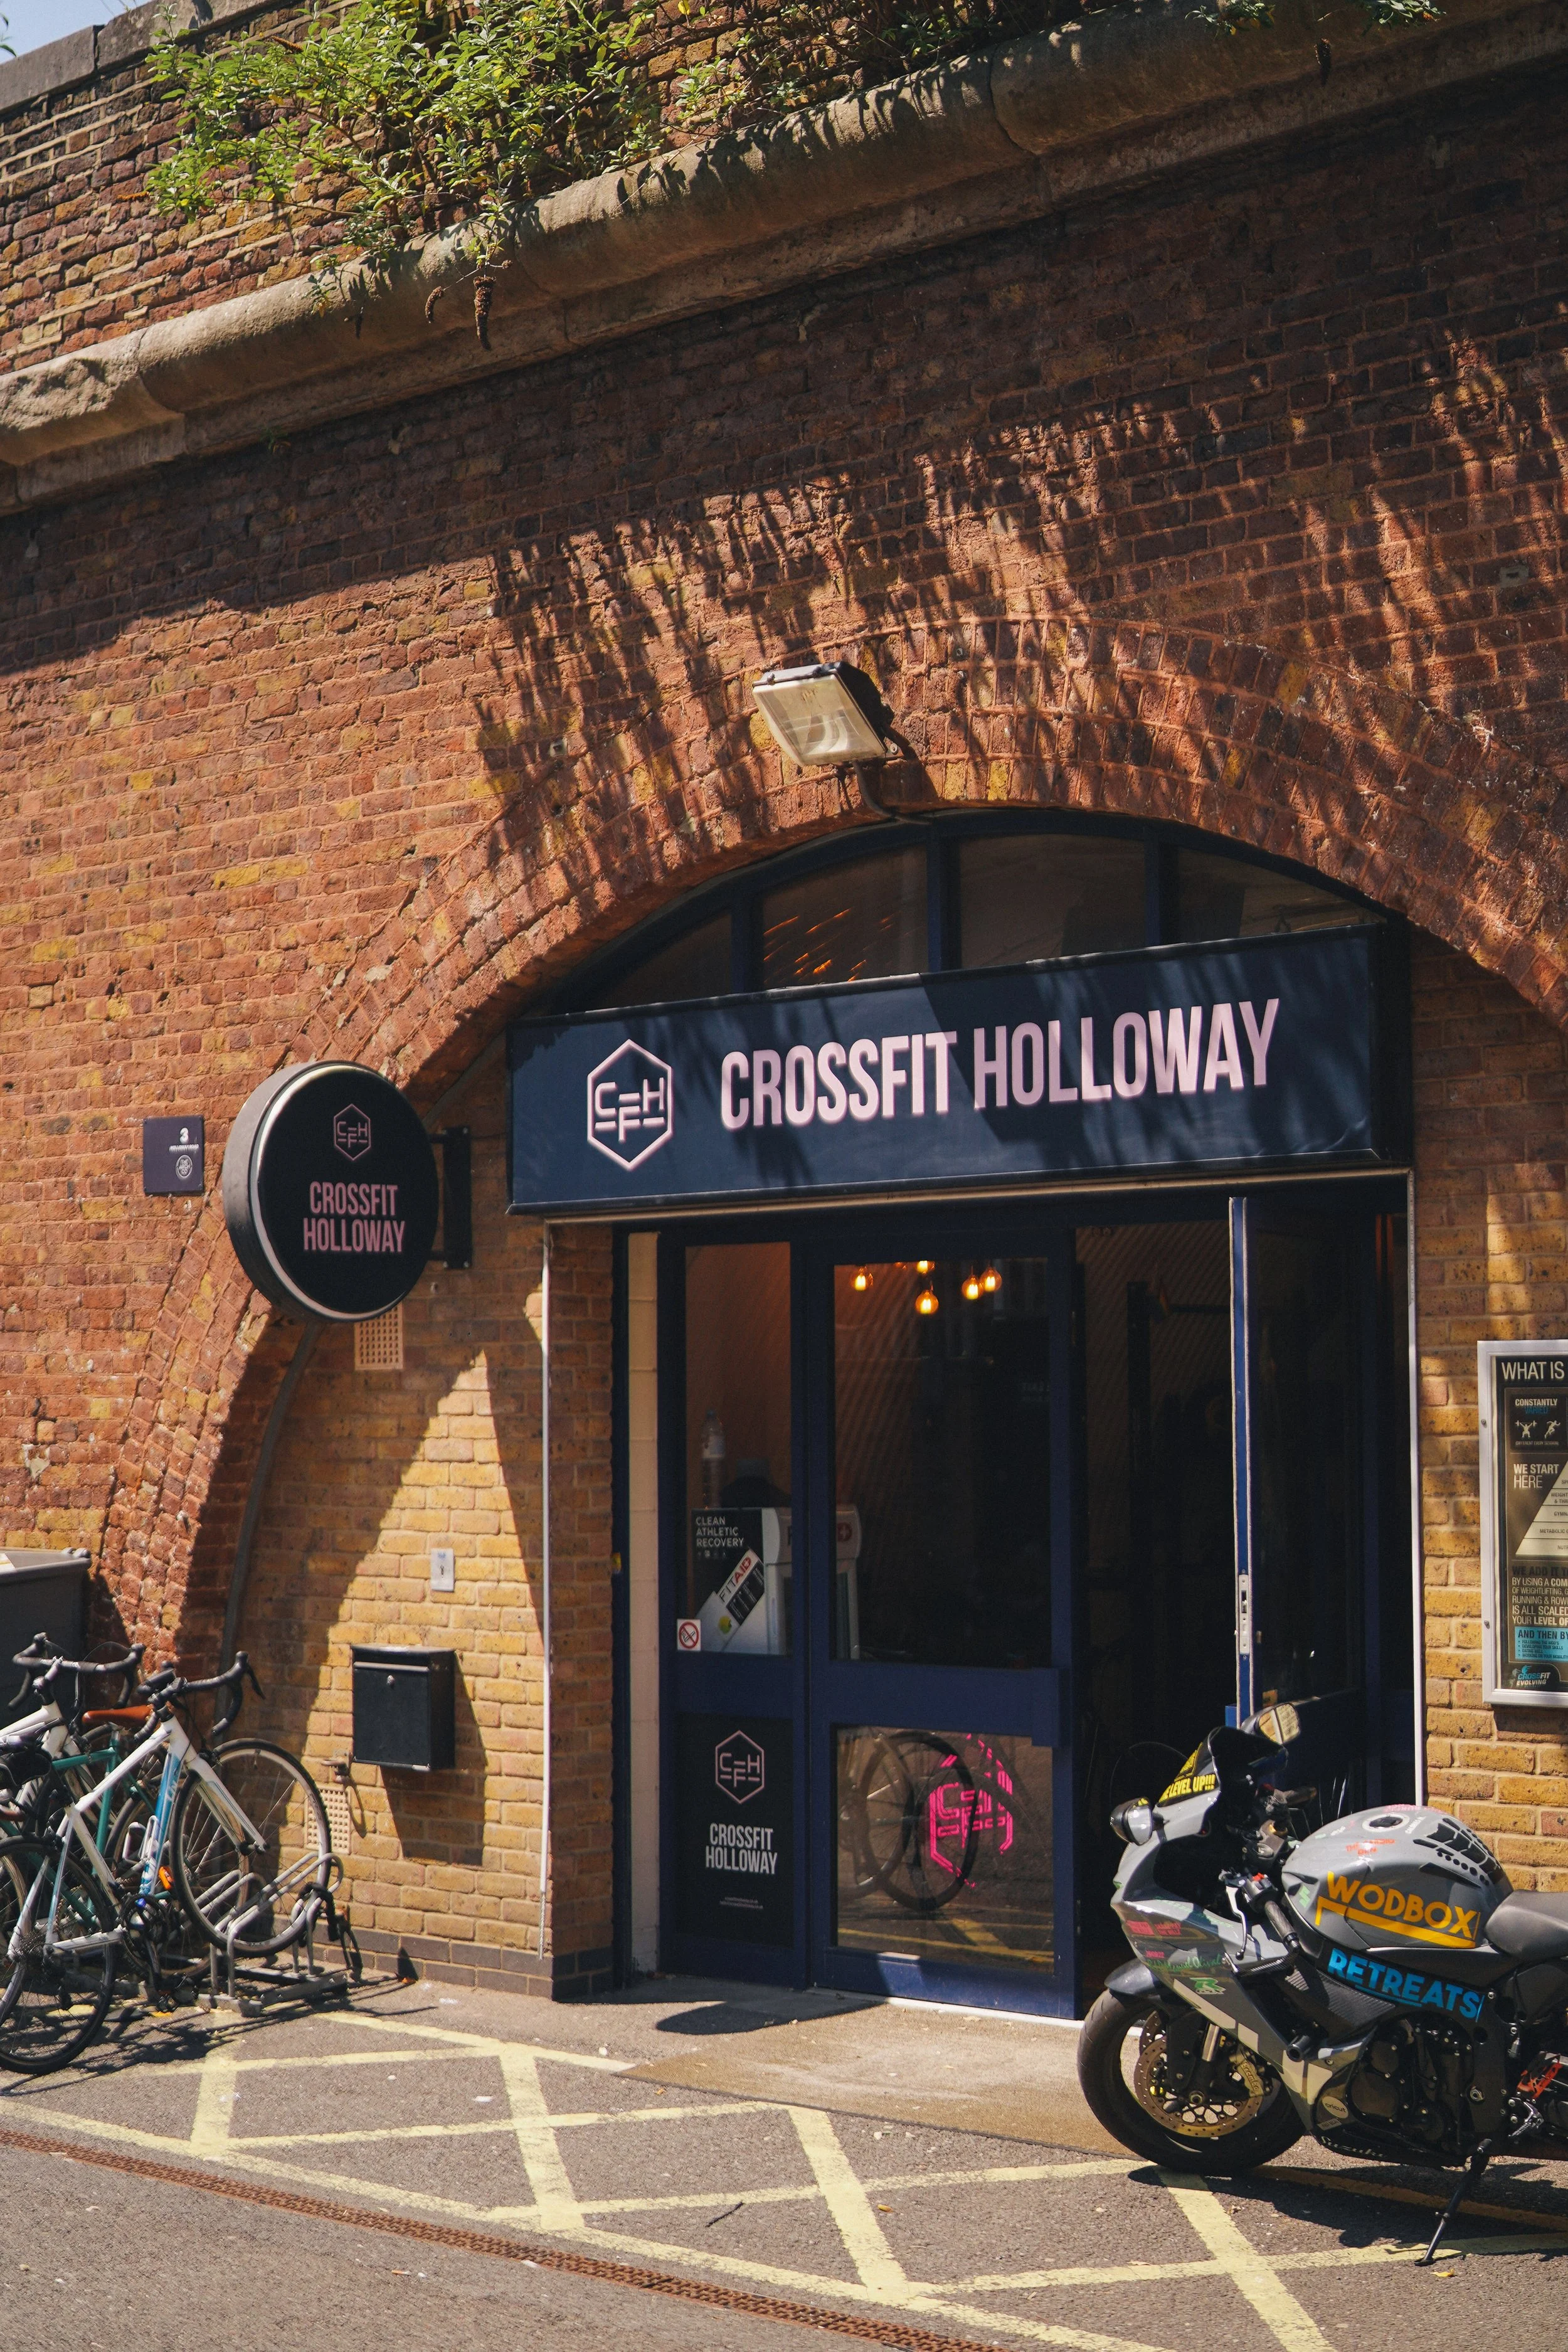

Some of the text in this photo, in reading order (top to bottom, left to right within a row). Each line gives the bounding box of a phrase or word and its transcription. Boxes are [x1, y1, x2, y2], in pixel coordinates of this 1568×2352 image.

[721, 998, 1279, 1130] CROSSFIT HOLLOWAY
[179, 1127, 189, 1143] 3
[309, 1181, 399, 1216] CROSSFIT
[304, 1217, 405, 1253] HOLLOWAY
[1502, 1361, 1565, 1380] WHAT IS
[1515, 1398, 1558, 1406] CONSTANTLY
[1513, 1464, 1559, 1474] WE START
[1513, 1475, 1543, 1488] HERE
[696, 1516, 726, 1526] CLEAN
[696, 1527, 739, 1537] ATHLETIC
[696, 1537, 744, 1548] RECOVERY
[1512, 1565, 1527, 1575] WE
[1529, 1566, 1547, 1576] ADD
[719, 1557, 751, 1602] FITAID
[1512, 1577, 1521, 1586] BY
[1522, 1577, 1542, 1586] USING
[1521, 1587, 1564, 1596] WEIGHTLIFTING,
[1512, 1596, 1542, 1604] RUNNING
[1544, 1596, 1549, 1604] &
[1512, 1605, 1568, 1616] IS ALL SCALED
[1512, 1616, 1532, 1624] YOUR
[1534, 1617, 1557, 1625] LEVEL
[1518, 1629, 1568, 1639] AND THEN BY
[1518, 1672, 1550, 1680] CROSSFIT
[1168, 1777, 1192, 1798] LEVEL
[1193, 1774, 1216, 1793] UP!!!
[709, 1822, 773, 1850] CROSSFIT
[705, 1845, 778, 1875] HOLLOWAY
[1327, 1871, 1476, 1939] WODBOX
[1327, 1947, 1480, 2019] RETREATS
[1325, 2102, 1347, 2114] cricut
